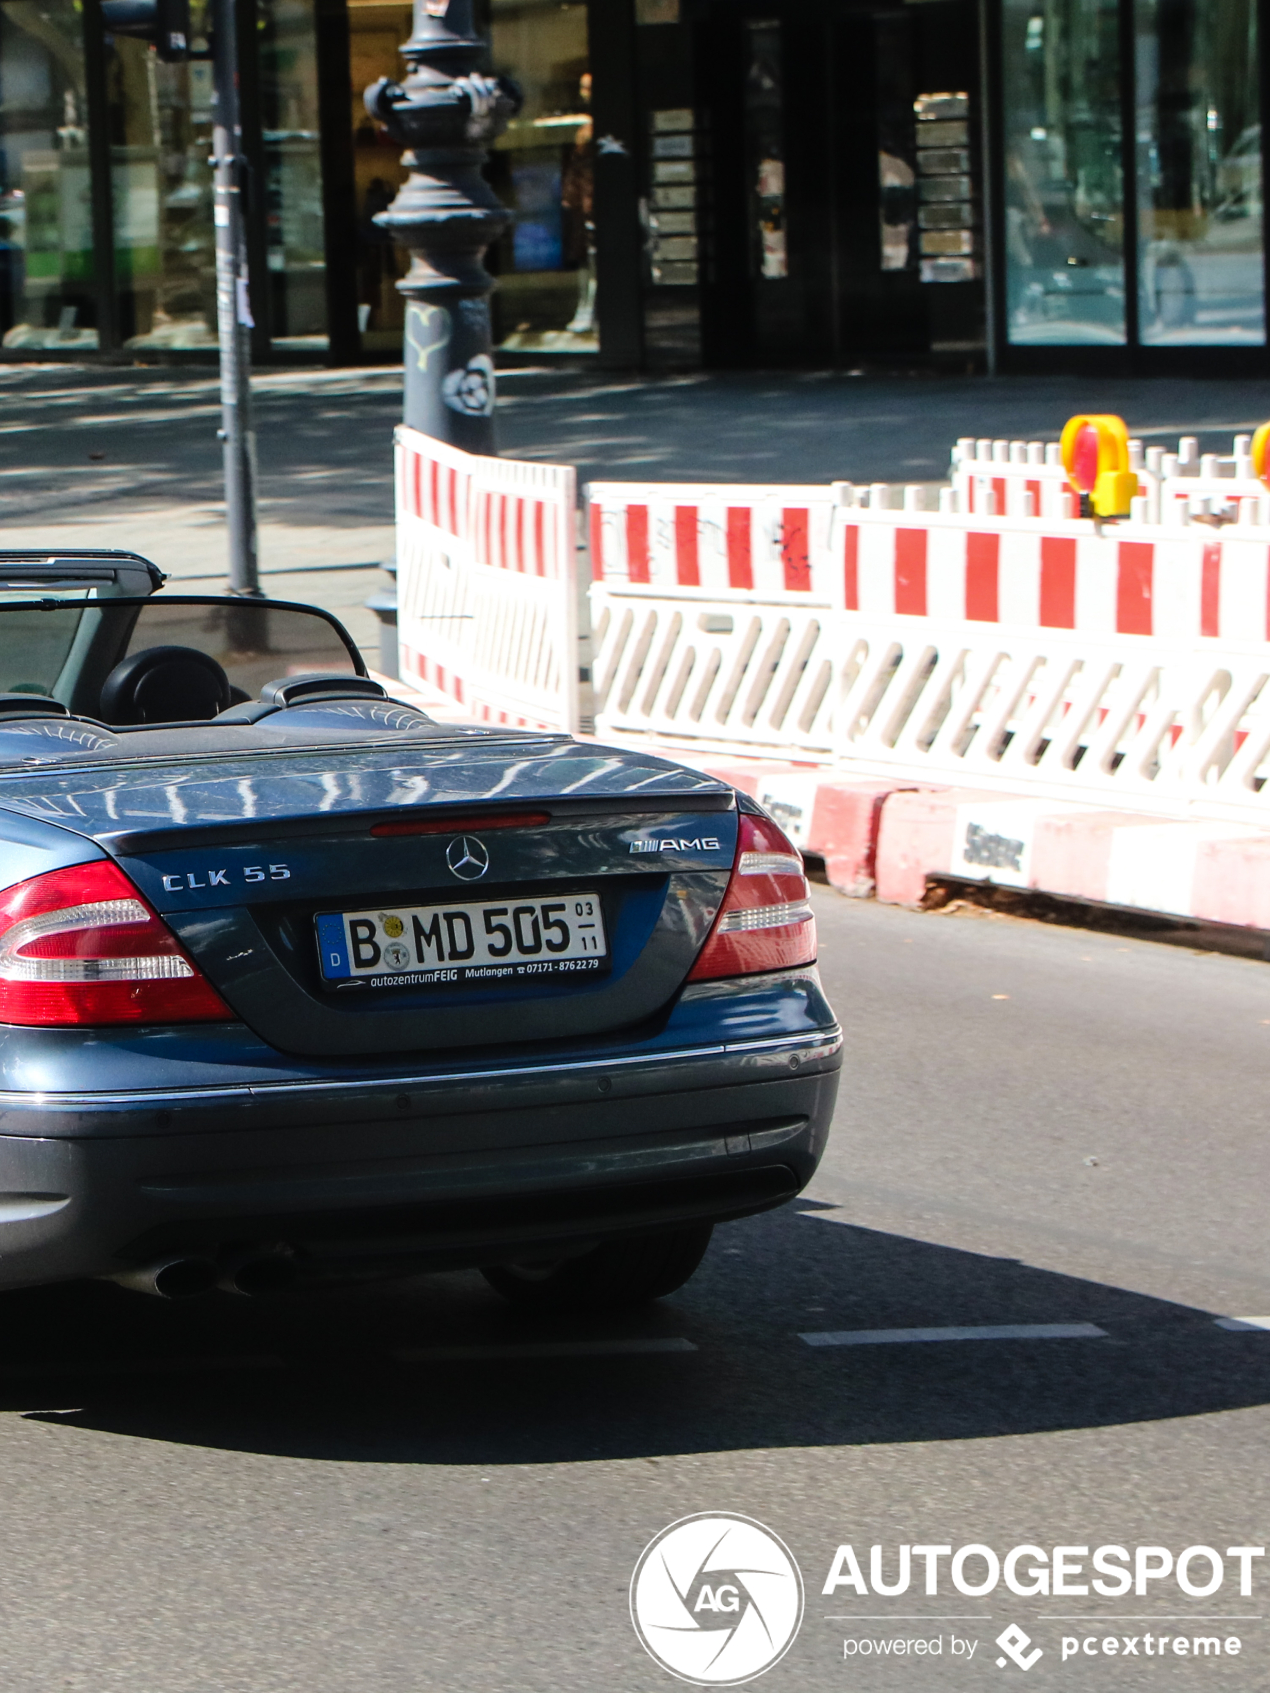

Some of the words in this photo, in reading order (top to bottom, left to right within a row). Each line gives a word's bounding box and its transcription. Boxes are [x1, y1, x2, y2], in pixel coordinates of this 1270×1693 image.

[659, 837, 721, 853] AMG
[162, 869, 232, 892] CLK
[243, 863, 292, 883] 55
[574, 901, 594, 917] 03
[349, 918, 381, 969] B
[412, 910, 476, 964] MD
[482, 903, 571, 958] 505
[581, 935, 598, 951] 11
[330, 952, 341, 967] D
[370, 969, 458, 988] autozentrumFEIG
[465, 966, 513, 979] Mutlangen
